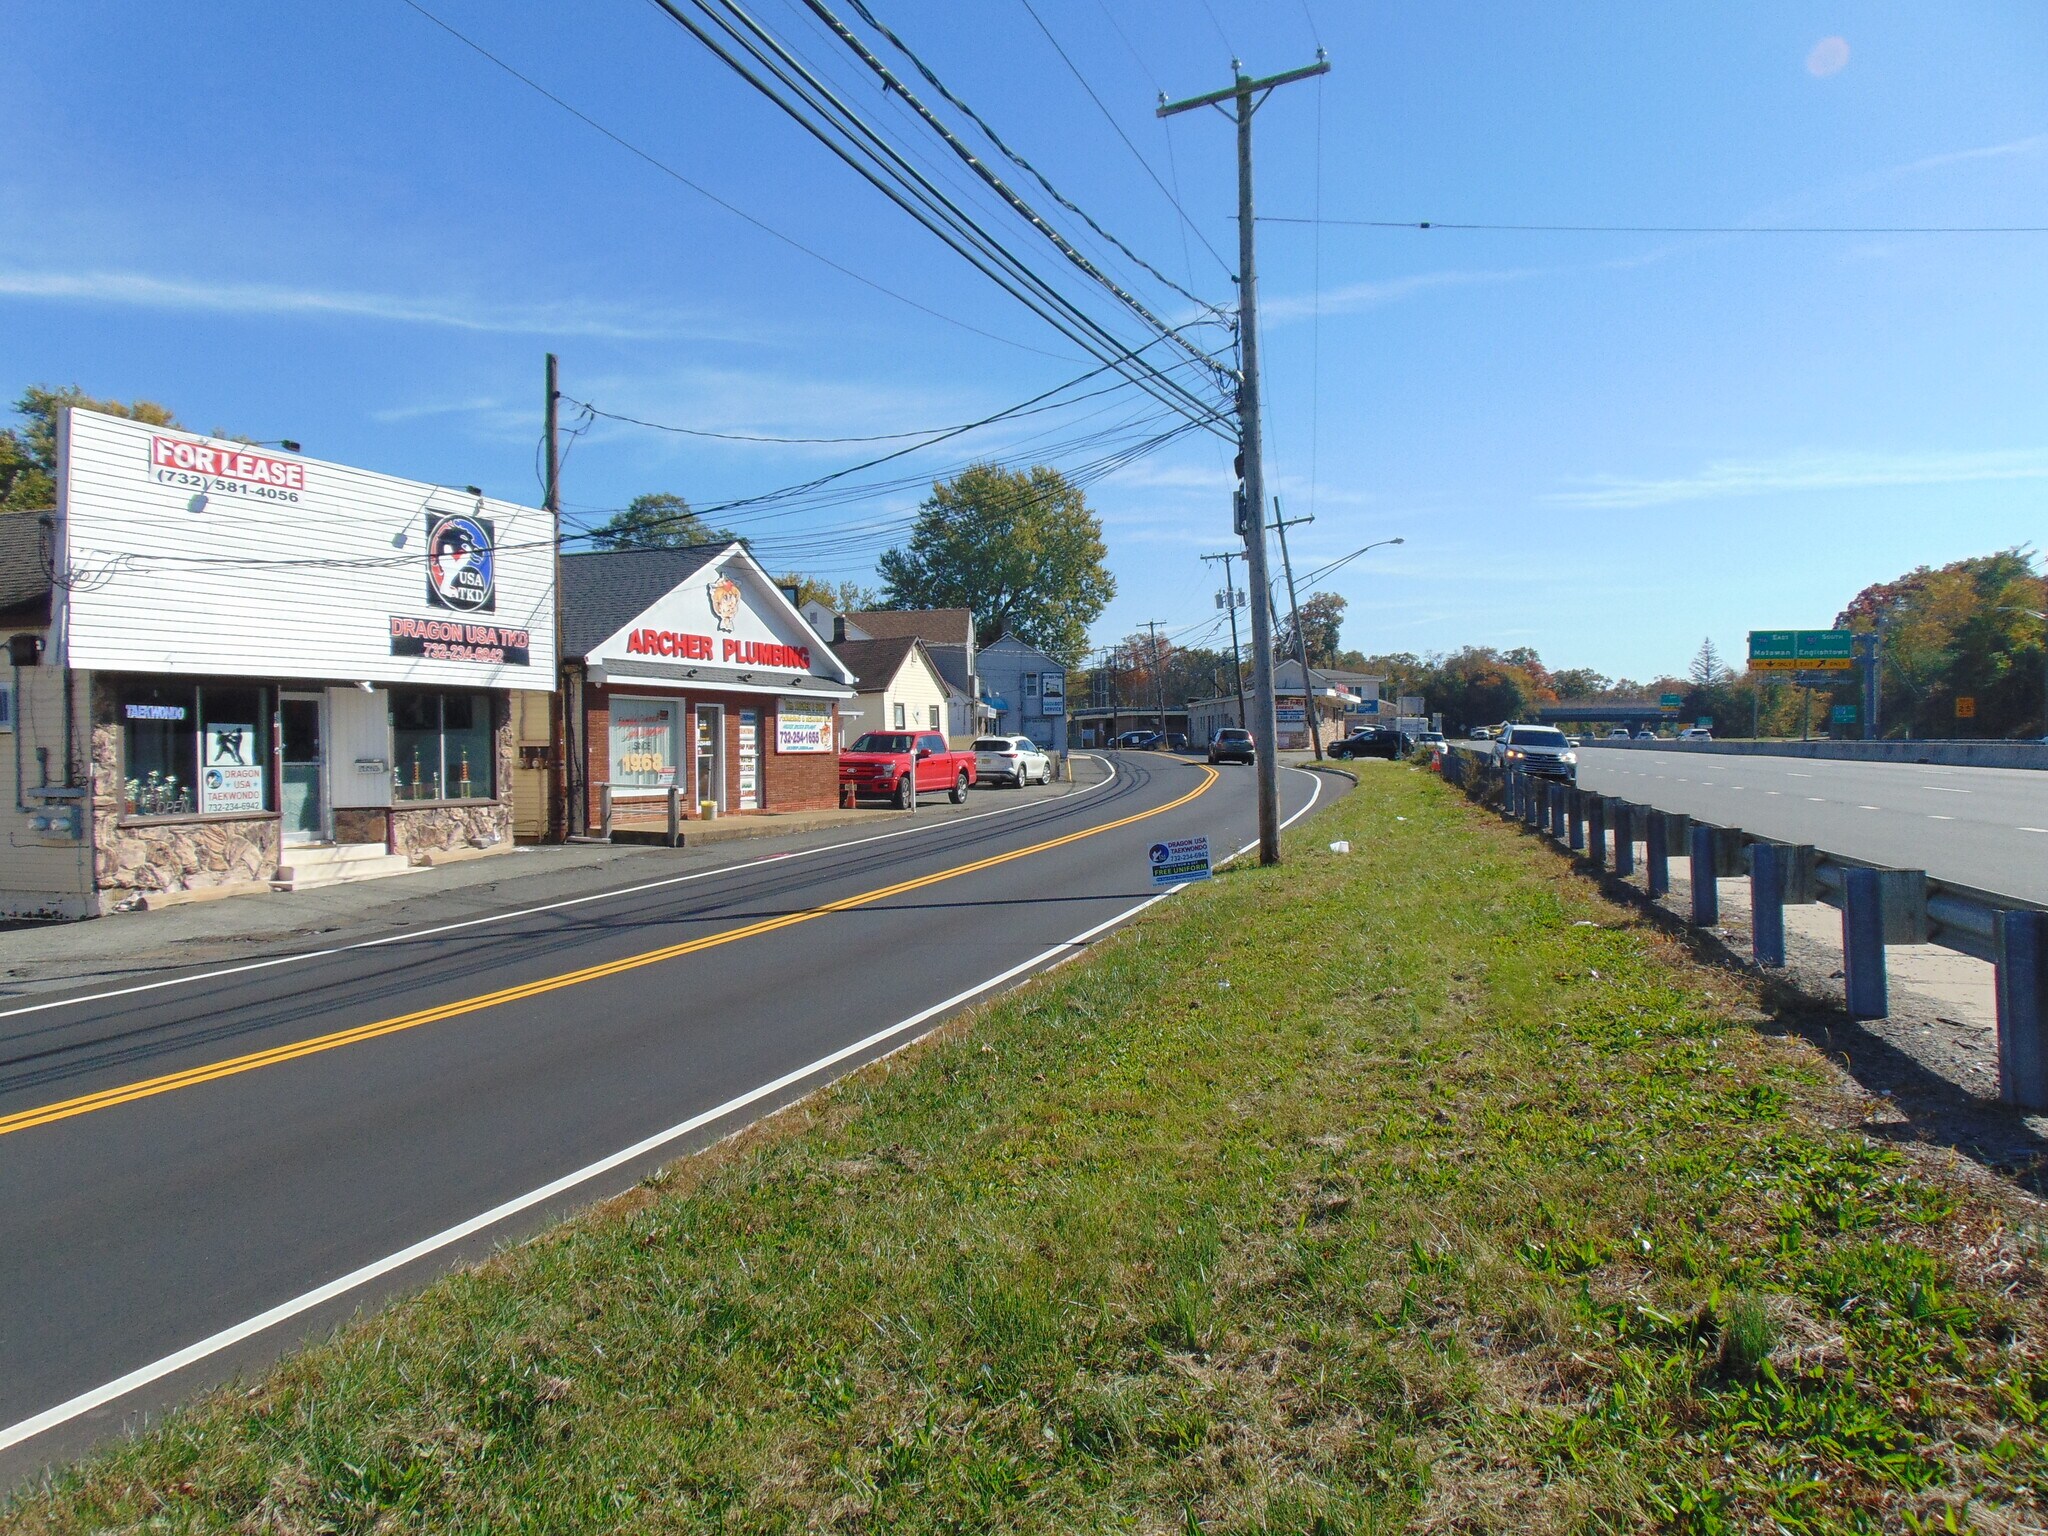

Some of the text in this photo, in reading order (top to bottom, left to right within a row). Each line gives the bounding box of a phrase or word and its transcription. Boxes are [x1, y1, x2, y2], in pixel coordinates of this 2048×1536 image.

[156, 438, 302, 488] FOR LEASE
[157, 468, 299, 503] (732) 581-4056
[459, 571, 484, 587] USA
[458, 588, 484, 602] TKD
[391, 617, 529, 648] DRAGON USA TKD
[626, 628, 811, 670] ARCHER PLUMBING
[125, 704, 185, 720] TAEKWONDO
[622, 752, 663, 772] 1968
[224, 769, 260, 779] DRAGON
[233, 781, 251, 789] USA
[207, 791, 260, 801] TAEKWONDO
[156, 800, 190, 815] OPEN
[208, 802, 260, 812] 732-234-6942
[1168, 839, 1192, 847] DRAGON
[1171, 844, 1207, 853] TAEKWONDO
[1154, 868, 1172, 876] FREE
[1173, 863, 1207, 874] UNIFORM
